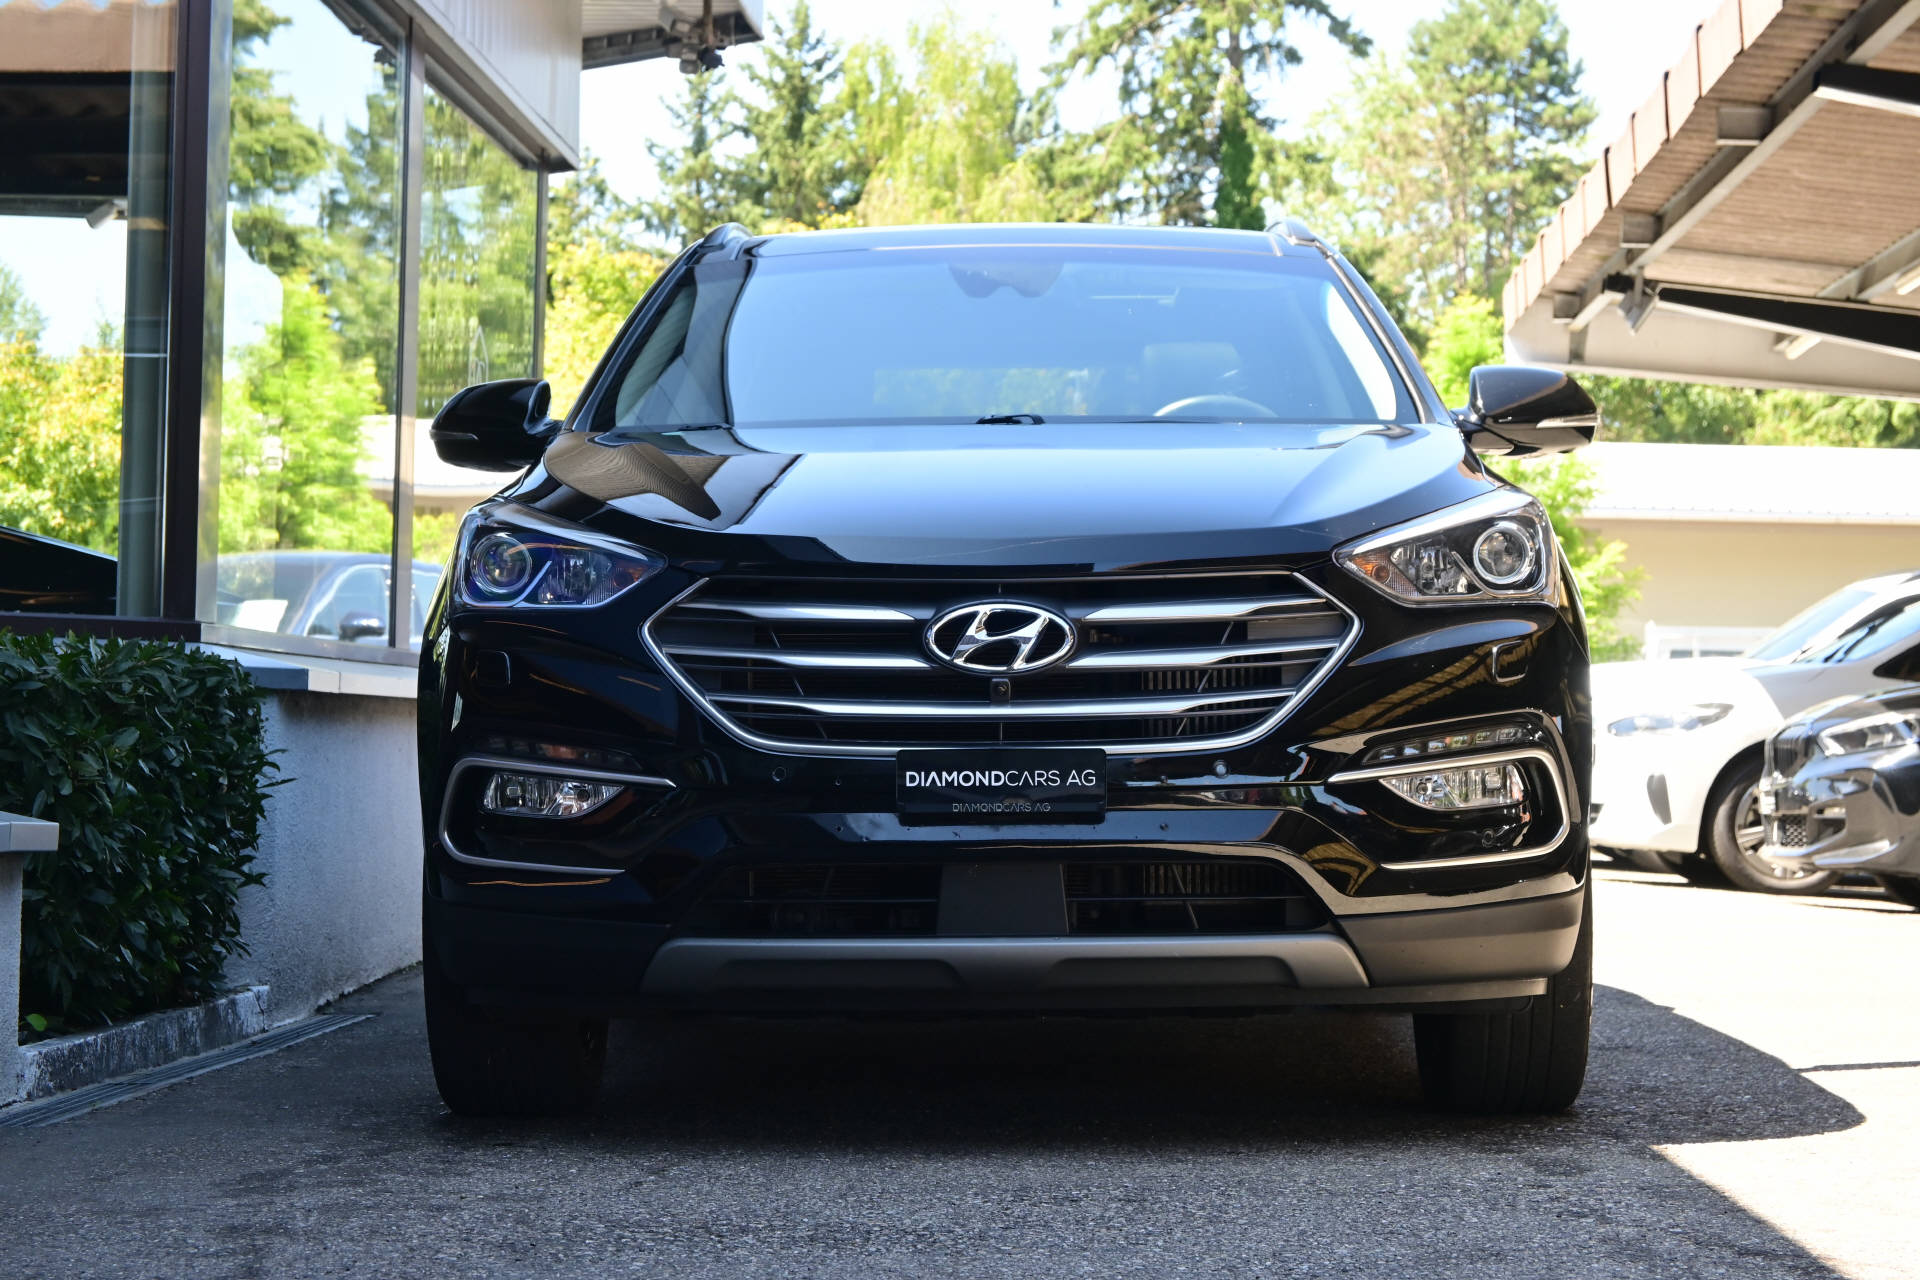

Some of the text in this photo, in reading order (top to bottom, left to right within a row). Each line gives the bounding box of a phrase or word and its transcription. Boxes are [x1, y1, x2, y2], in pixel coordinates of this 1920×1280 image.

[906, 769, 1096, 787] DIAMONDCARS AG
[952, 803, 1051, 812] DIAMONDCARS AG
